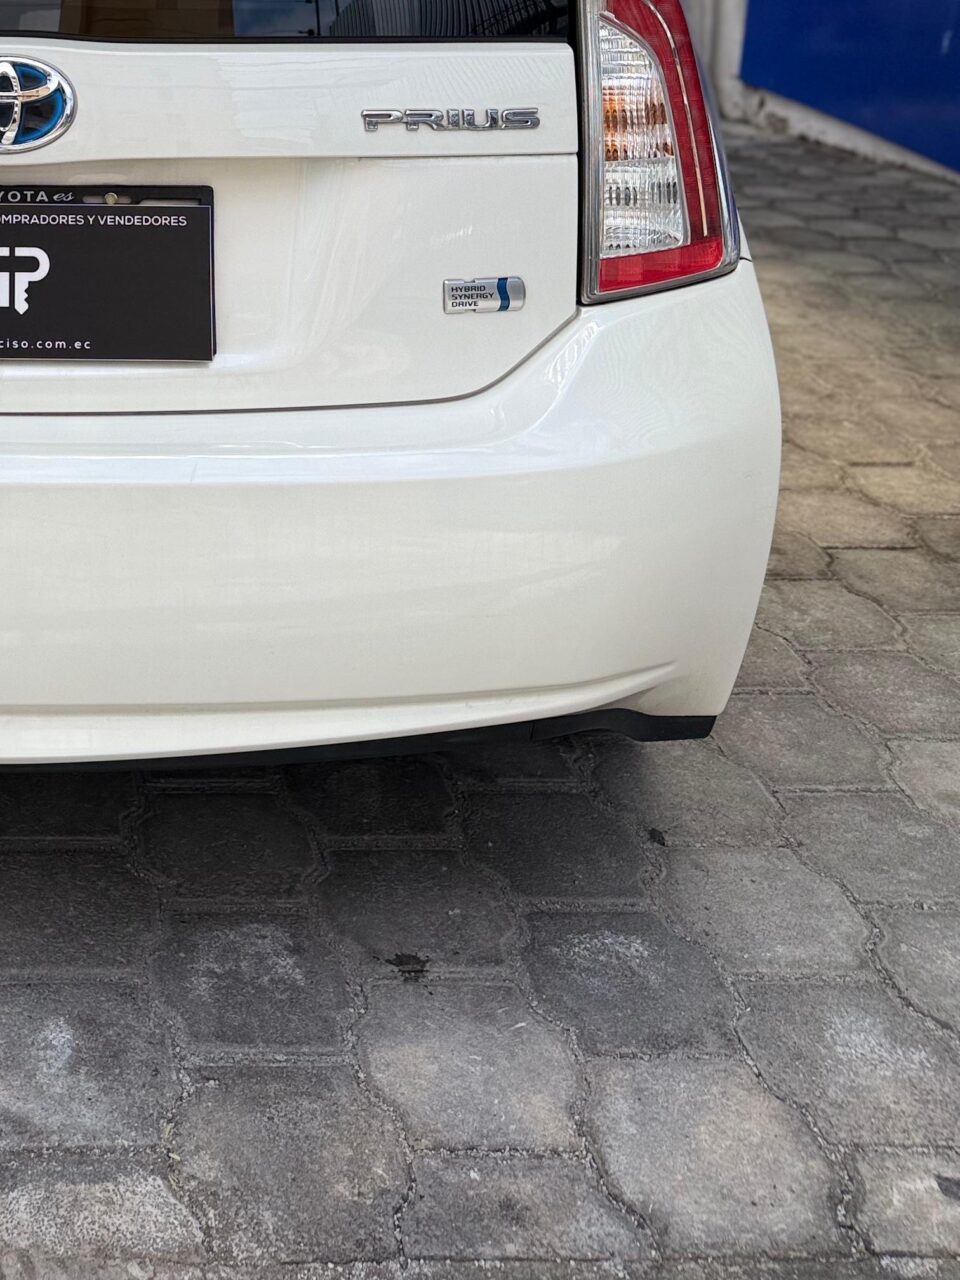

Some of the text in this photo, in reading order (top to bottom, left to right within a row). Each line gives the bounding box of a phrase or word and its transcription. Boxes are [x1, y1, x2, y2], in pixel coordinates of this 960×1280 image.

[361, 107, 541, 132] PRIUS
[52, 191, 75, 202] es
[87, 215, 97, 225] Y
[99, 215, 187, 227] VENDEDORES
[450, 285, 486, 293] HYBRID
[451, 292, 494, 301] SYNERGY
[451, 300, 479, 308] DRIVE
